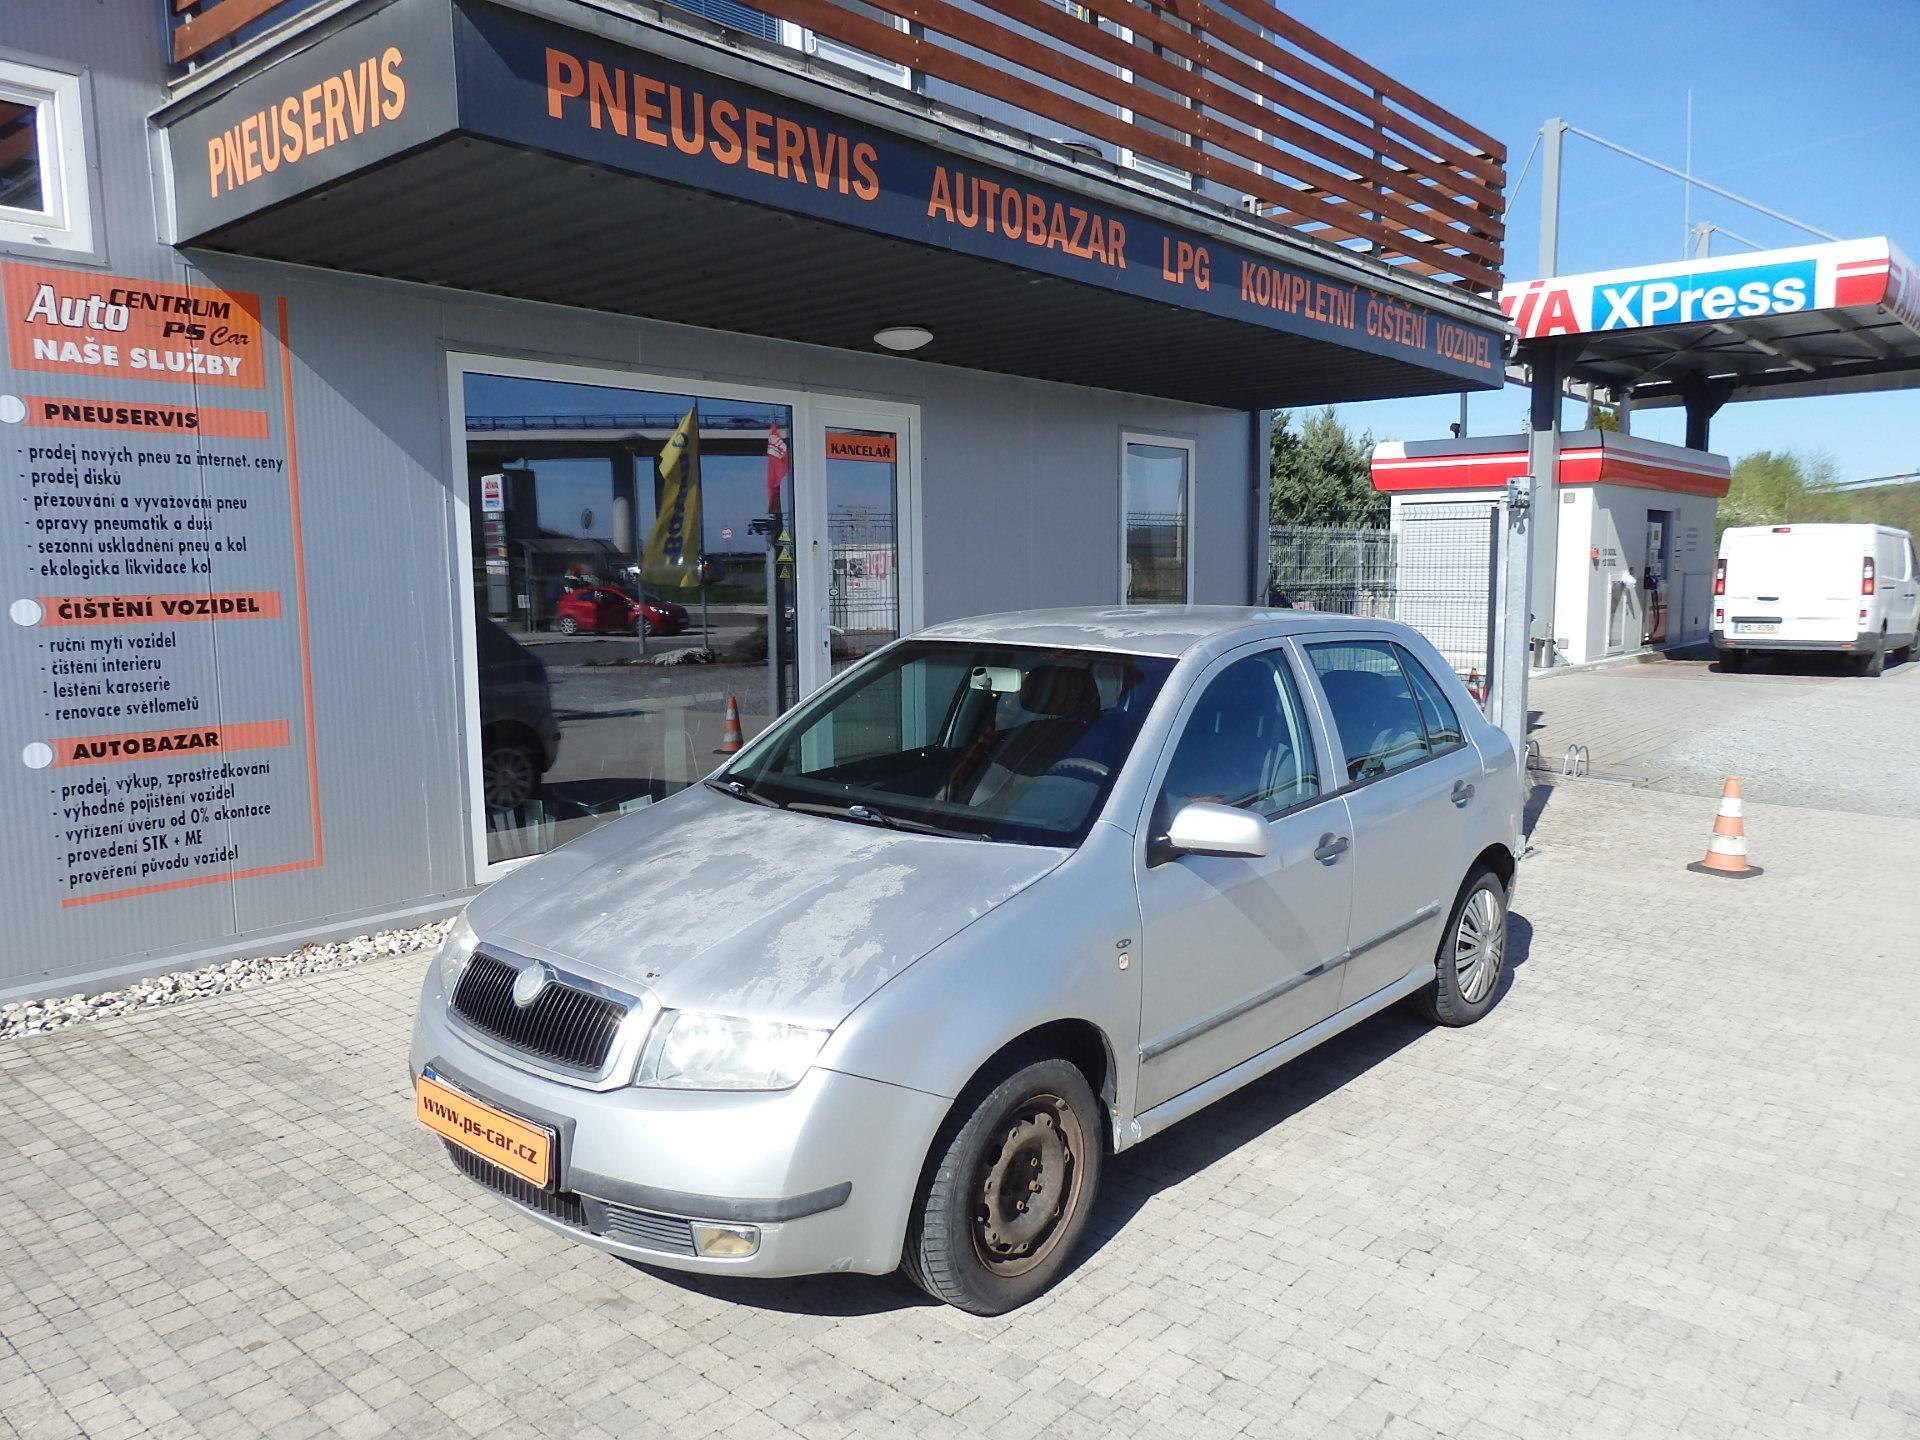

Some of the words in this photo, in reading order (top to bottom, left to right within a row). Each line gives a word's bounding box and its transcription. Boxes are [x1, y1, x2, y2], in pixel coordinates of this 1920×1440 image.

[208, 47, 406, 199] PNEUSERVIS
[545, 47, 880, 201] PNEUSERVIS
[928, 166, 1127, 269] AUTOBAZAR
[1162, 236, 1211, 292] LPG
[1241, 260, 1359, 330] KOMPLETNÍ
[1366, 289, 1431, 350] ČIŠTĚNÍ
[1436, 322, 1492, 369] VOZIDEL
[109, 288, 231, 319] CENTRUM
[1600, 277, 1807, 330] XPress
[162, 322, 206, 341] PS
[209, 325, 250, 347] Car
[33, 336, 119, 367] NAŠE
[130, 347, 244, 377] SLUŽBY
[44, 403, 199, 429] PNEUSERVIS
[29, 443, 77, 465] prodej
[81, 446, 133, 466] nových
[138, 452, 170, 467] pneu
[176, 453, 191, 465] za
[255, 458, 283, 472] ceny
[831, 442, 891, 458] KANCELÁŘ
[31, 467, 79, 488] prodej
[84, 468, 121, 485] disků
[34, 492, 115, 511] přezouvání
[121, 497, 129, 507] a
[134, 494, 212, 513] vyvažování
[217, 499, 247, 513] pneu
[36, 519, 88, 534] opravy
[94, 514, 169, 534] pneumatik
[174, 520, 182, 530] a
[38, 538, 93, 553] sezónní
[98, 536, 174, 552] uskladnění
[179, 541, 210, 556] pneu
[214, 541, 222, 551] a
[227, 536, 247, 551] kol
[41, 559, 120, 580] ekologická
[125, 558, 187, 574] likvidace
[192, 557, 212, 574] kol
[58, 597, 153, 620] ČIŠTĚNÍ
[160, 598, 259, 616] VOZIDEL
[50, 637, 85, 652] ruční
[91, 634, 123, 654] mytí
[128, 631, 176, 649] vozidel
[52, 658, 97, 675] čištění
[102, 655, 161, 672] interiéru
[53, 681, 101, 698] leštění
[106, 676, 170, 694] karoserie
[55, 705, 121, 720] renovace
[126, 696, 199, 715] světlometů
[72, 731, 220, 760] AUTOBAZAR
[167, 760, 270, 788] zprostředkování
[64, 798, 125, 822] výhodné
[131, 791, 185, 815] pojištění
[190, 783, 235, 802] vozidel
[66, 820, 123, 844] vyřízení
[128, 818, 166, 833] úvěru
[170, 810, 186, 826] od
[191, 806, 210, 823] 0%
[214, 804, 271, 821] akontace
[68, 840, 138, 868] provedení
[142, 833, 168, 852] STK
[185, 829, 203, 846] ME
[69, 861, 137, 889] prověření
[141, 853, 189, 877] původu
[194, 844, 239, 865] vozidel
[423, 1096, 538, 1165] www.ps-car.cz
